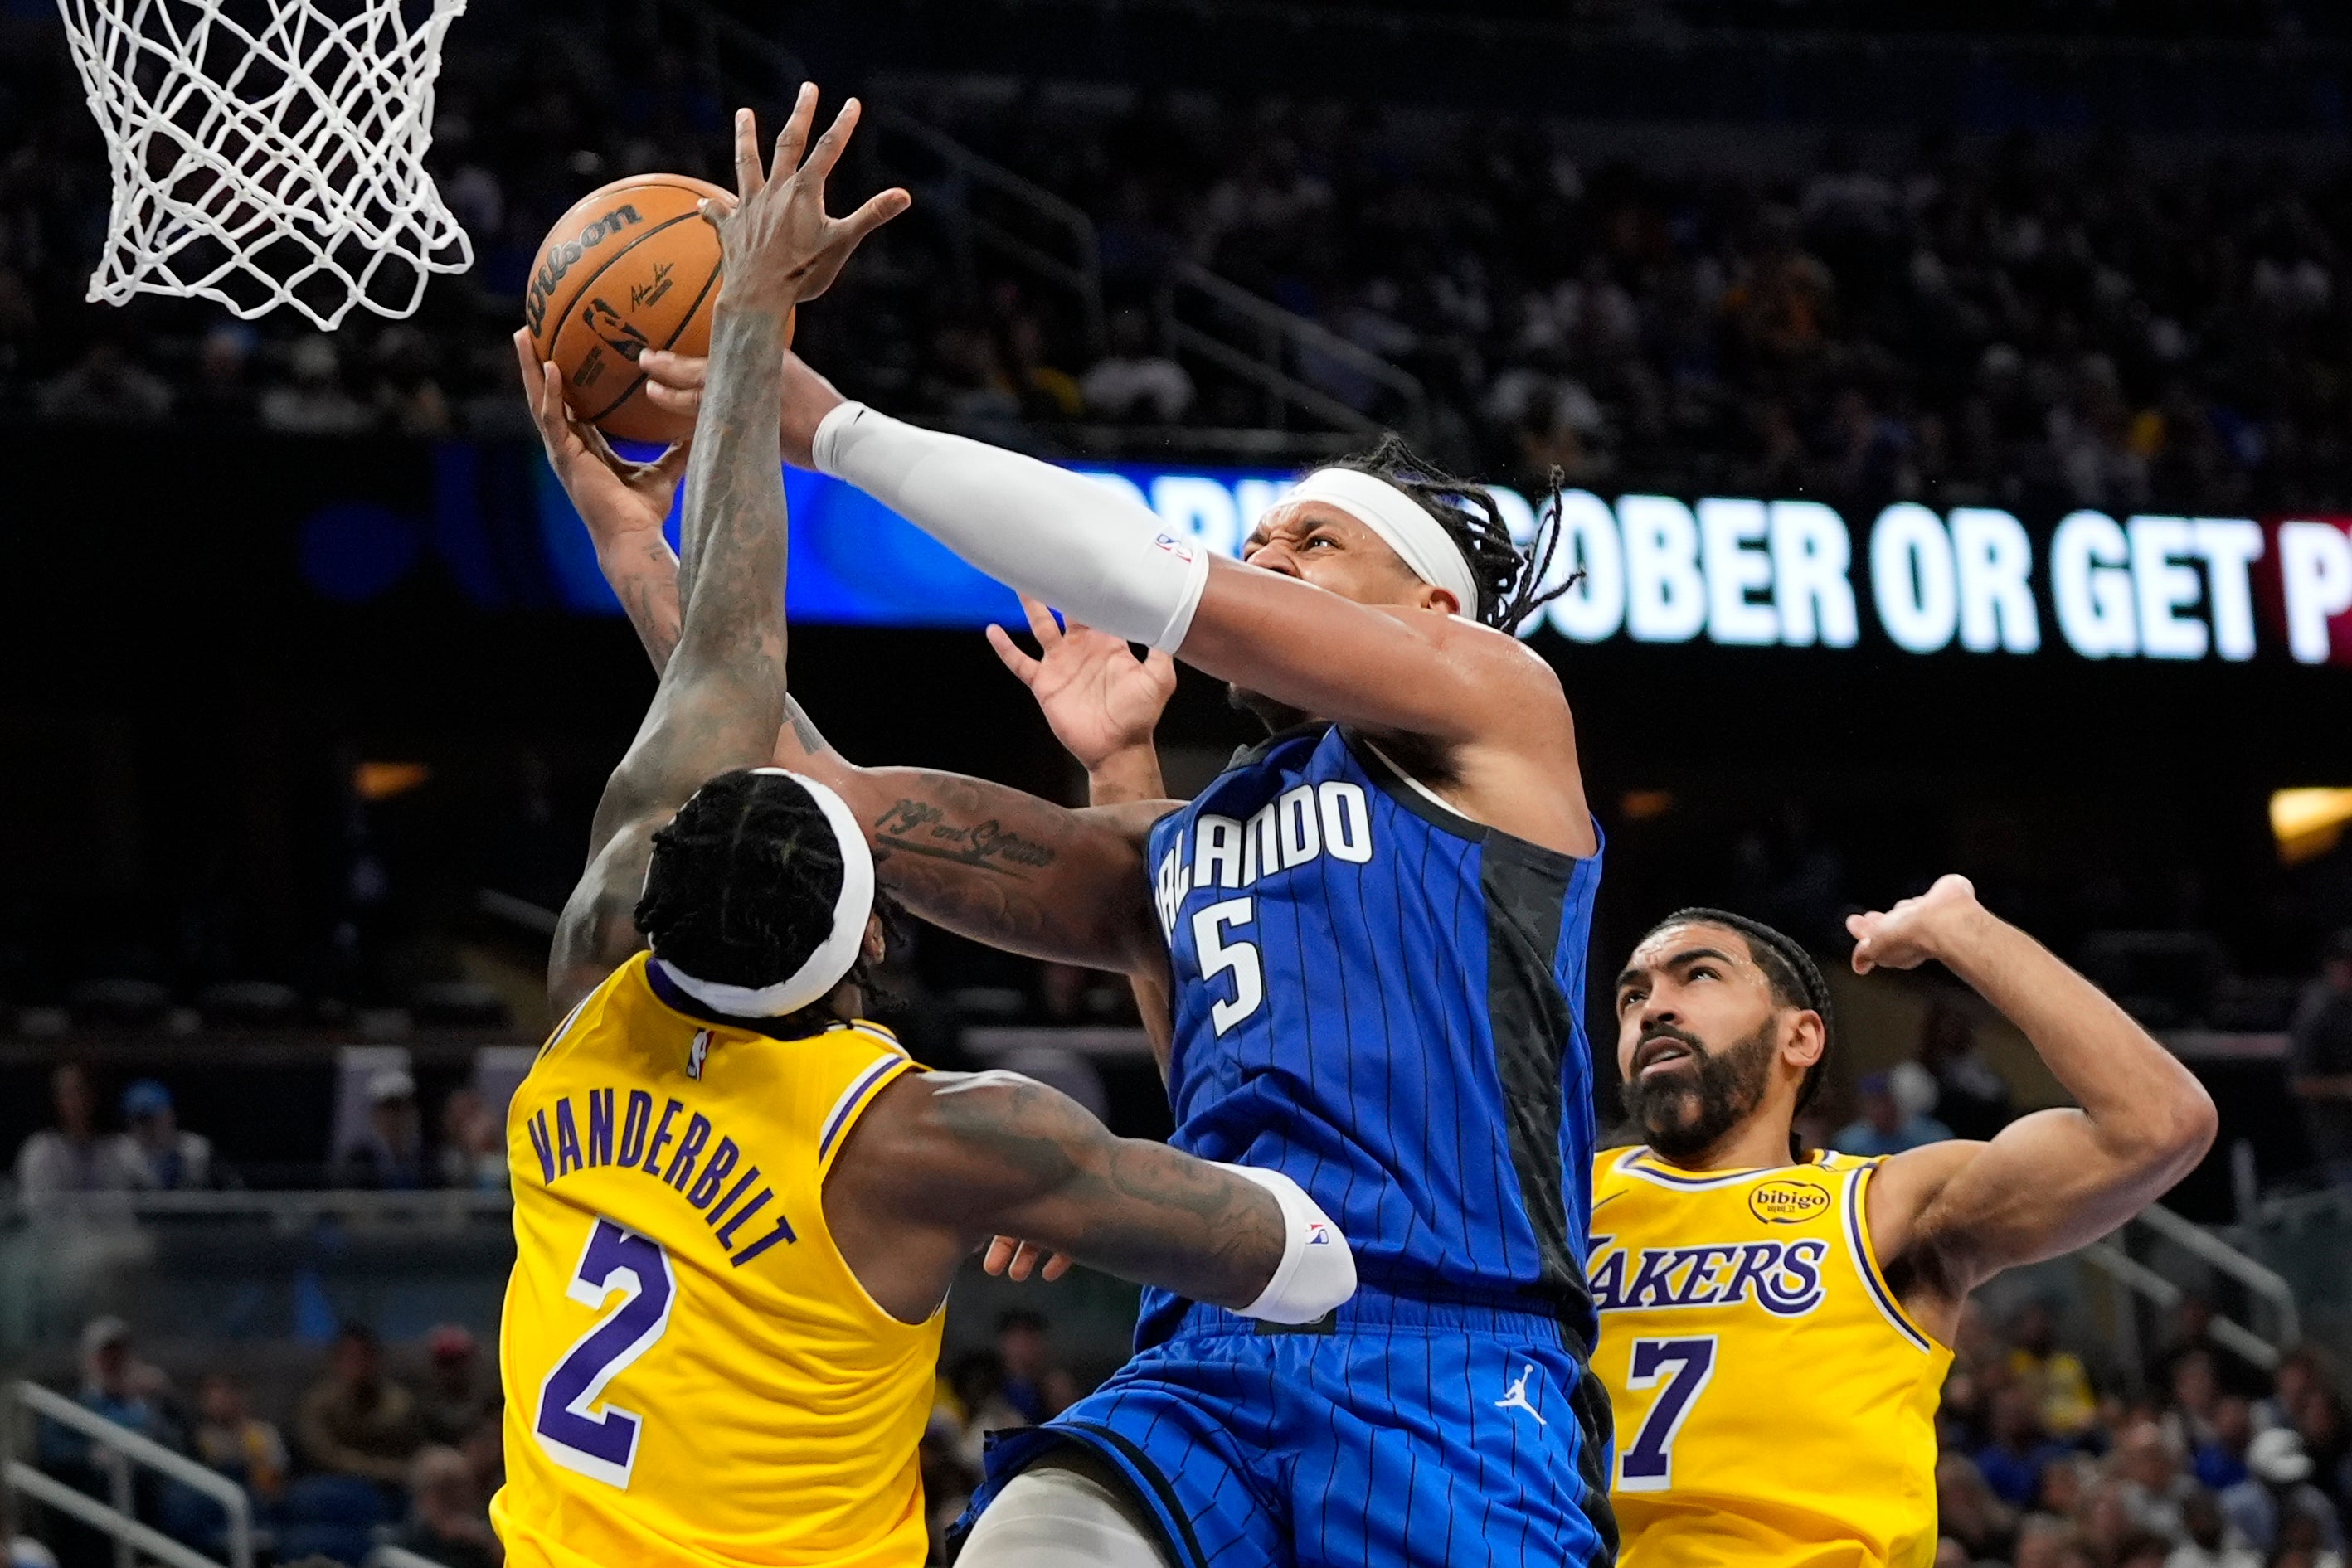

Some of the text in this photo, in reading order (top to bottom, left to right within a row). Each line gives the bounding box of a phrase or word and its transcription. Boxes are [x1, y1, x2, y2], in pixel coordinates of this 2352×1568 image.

[527, 203, 644, 339] Wilson
[1869, 501, 2041, 655] OR
[2050, 509, 2266, 662] GET
[2277, 520, 2352, 664] P
[1155, 780, 1373, 948] RLANDO
[1192, 896, 1263, 1038] 5
[527, 1087, 799, 1268] VANDERBILT
[1757, 1190, 1825, 1210] bibigo
[532, 1213, 678, 1491] 2
[1617, 1333, 1719, 1492] 7
